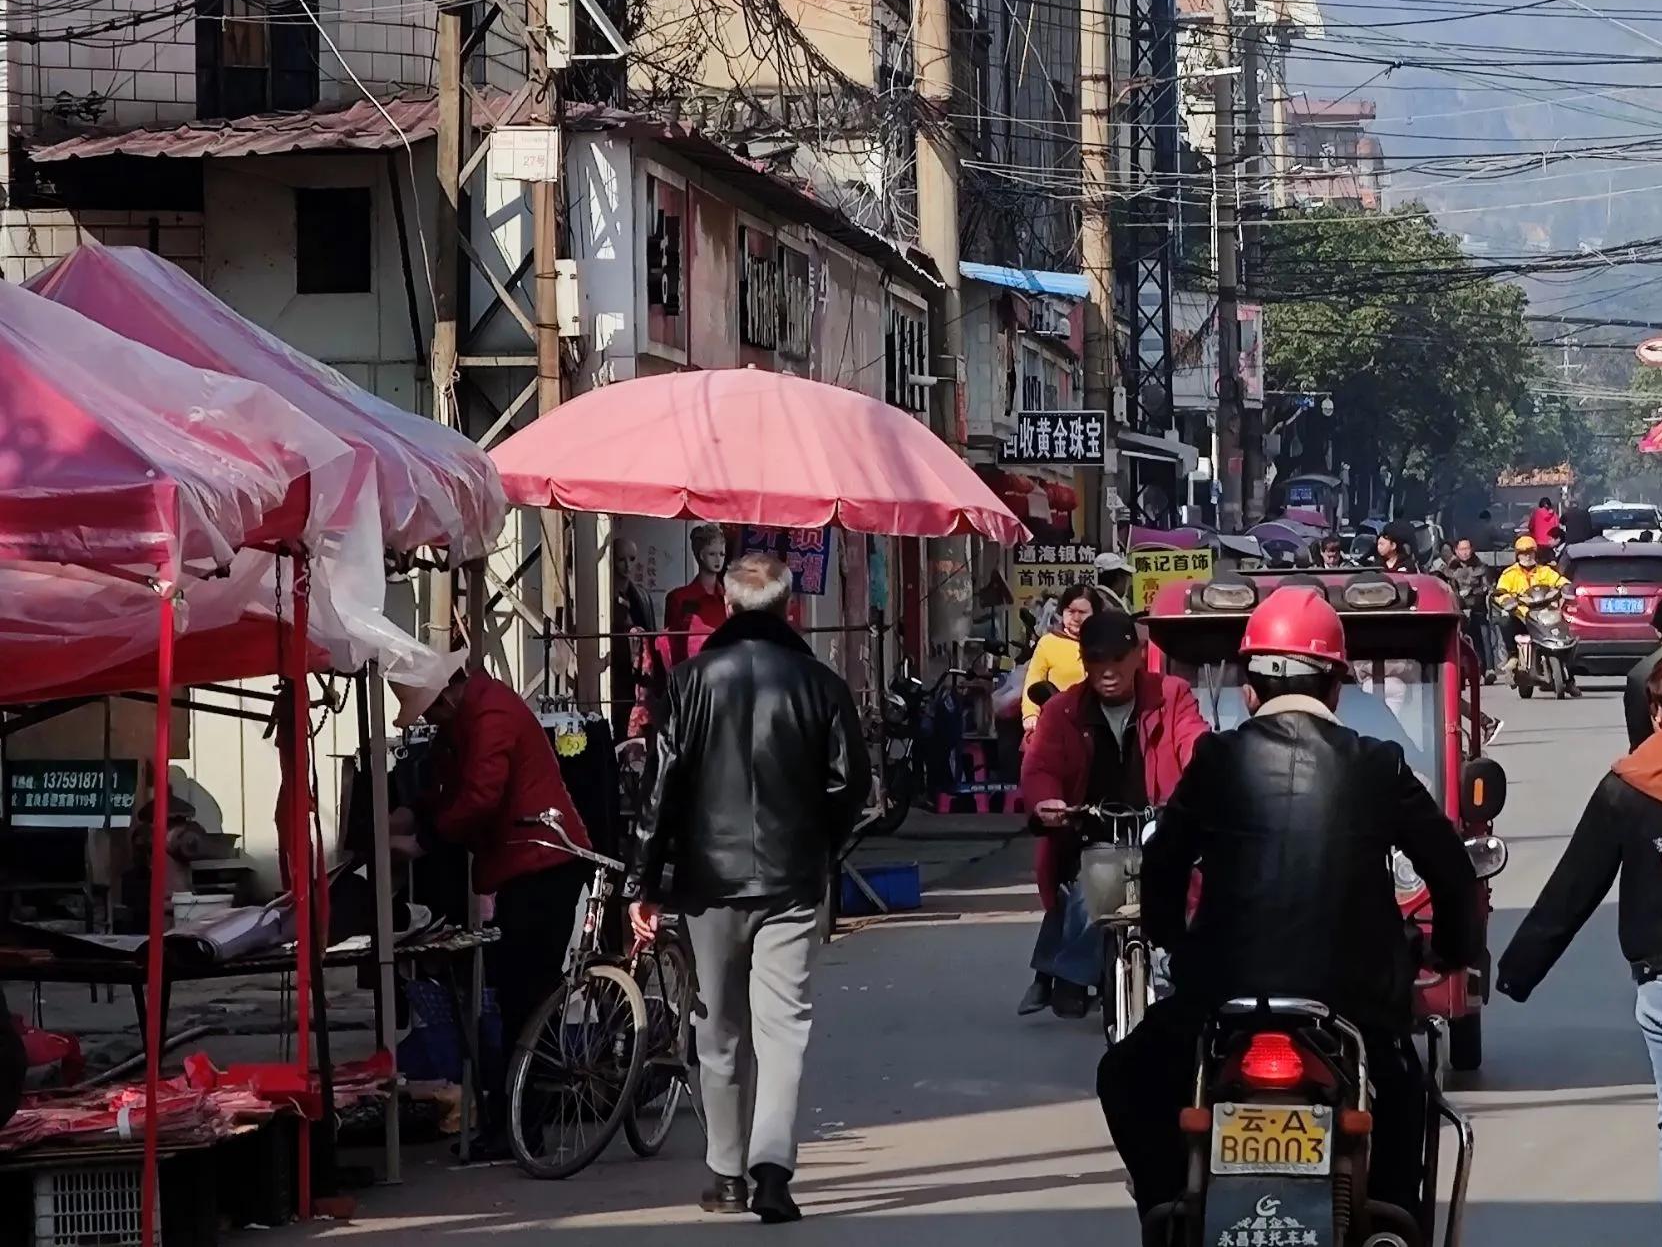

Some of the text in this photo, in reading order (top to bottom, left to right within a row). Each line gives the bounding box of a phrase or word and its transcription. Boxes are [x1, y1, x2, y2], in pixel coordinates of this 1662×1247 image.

[1018, 545, 1097, 564] 通海银饰
[1134, 553, 1209, 574] 陈记首饰
[1018, 568, 1096, 587] 首饰镶嵌
[42, 772, 118, 789] 1375918711
[1221, 1135, 1324, 1164] BG003
